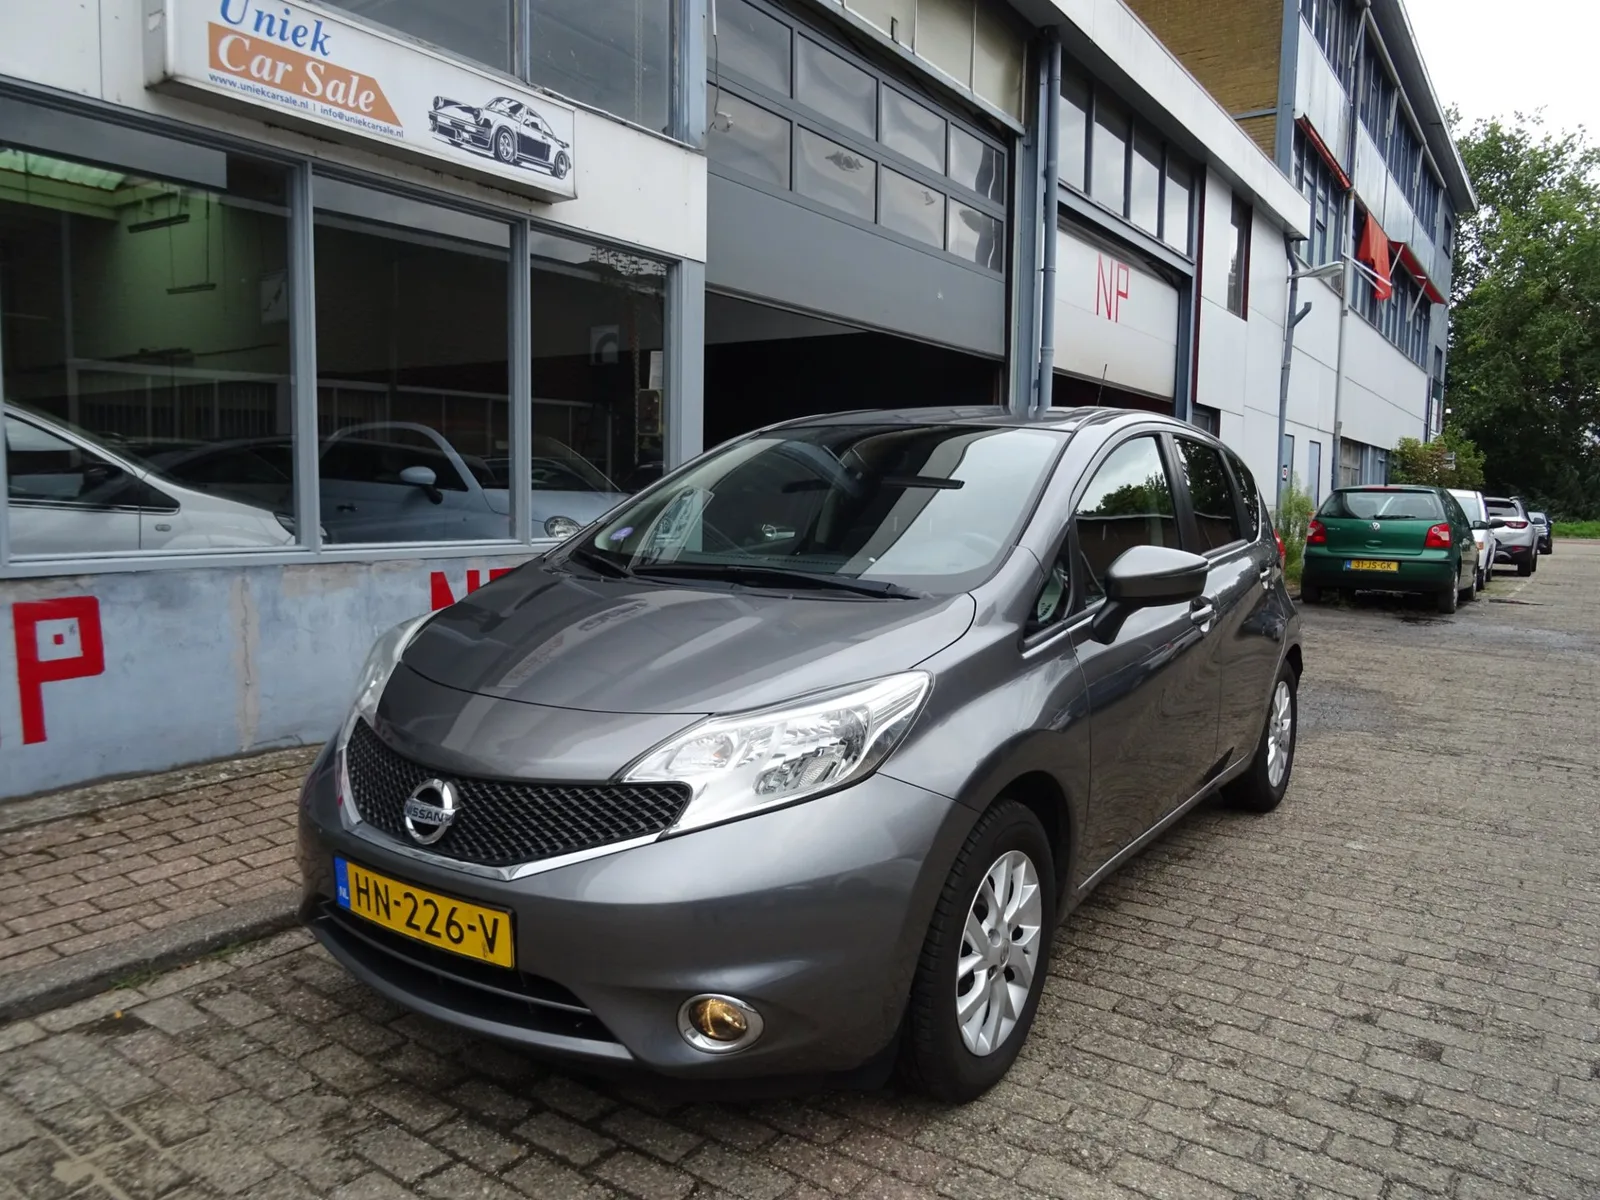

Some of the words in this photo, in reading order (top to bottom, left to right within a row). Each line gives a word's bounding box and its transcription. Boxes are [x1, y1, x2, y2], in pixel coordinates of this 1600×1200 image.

[220, 0, 331, 56] Uniek
[208, 73, 309, 110] www.uniekcarsale.nl
[320, 105, 404, 139] info@uniekcarsale.nl
[218, 34, 293, 84] Car
[302, 61, 375, 112] Sale
[1096, 252, 1129, 323] NP
[1354, 560, 1392, 570] 31-JS-GK
[339, 886, 350, 900] NL
[355, 872, 499, 954] HN-226-V
